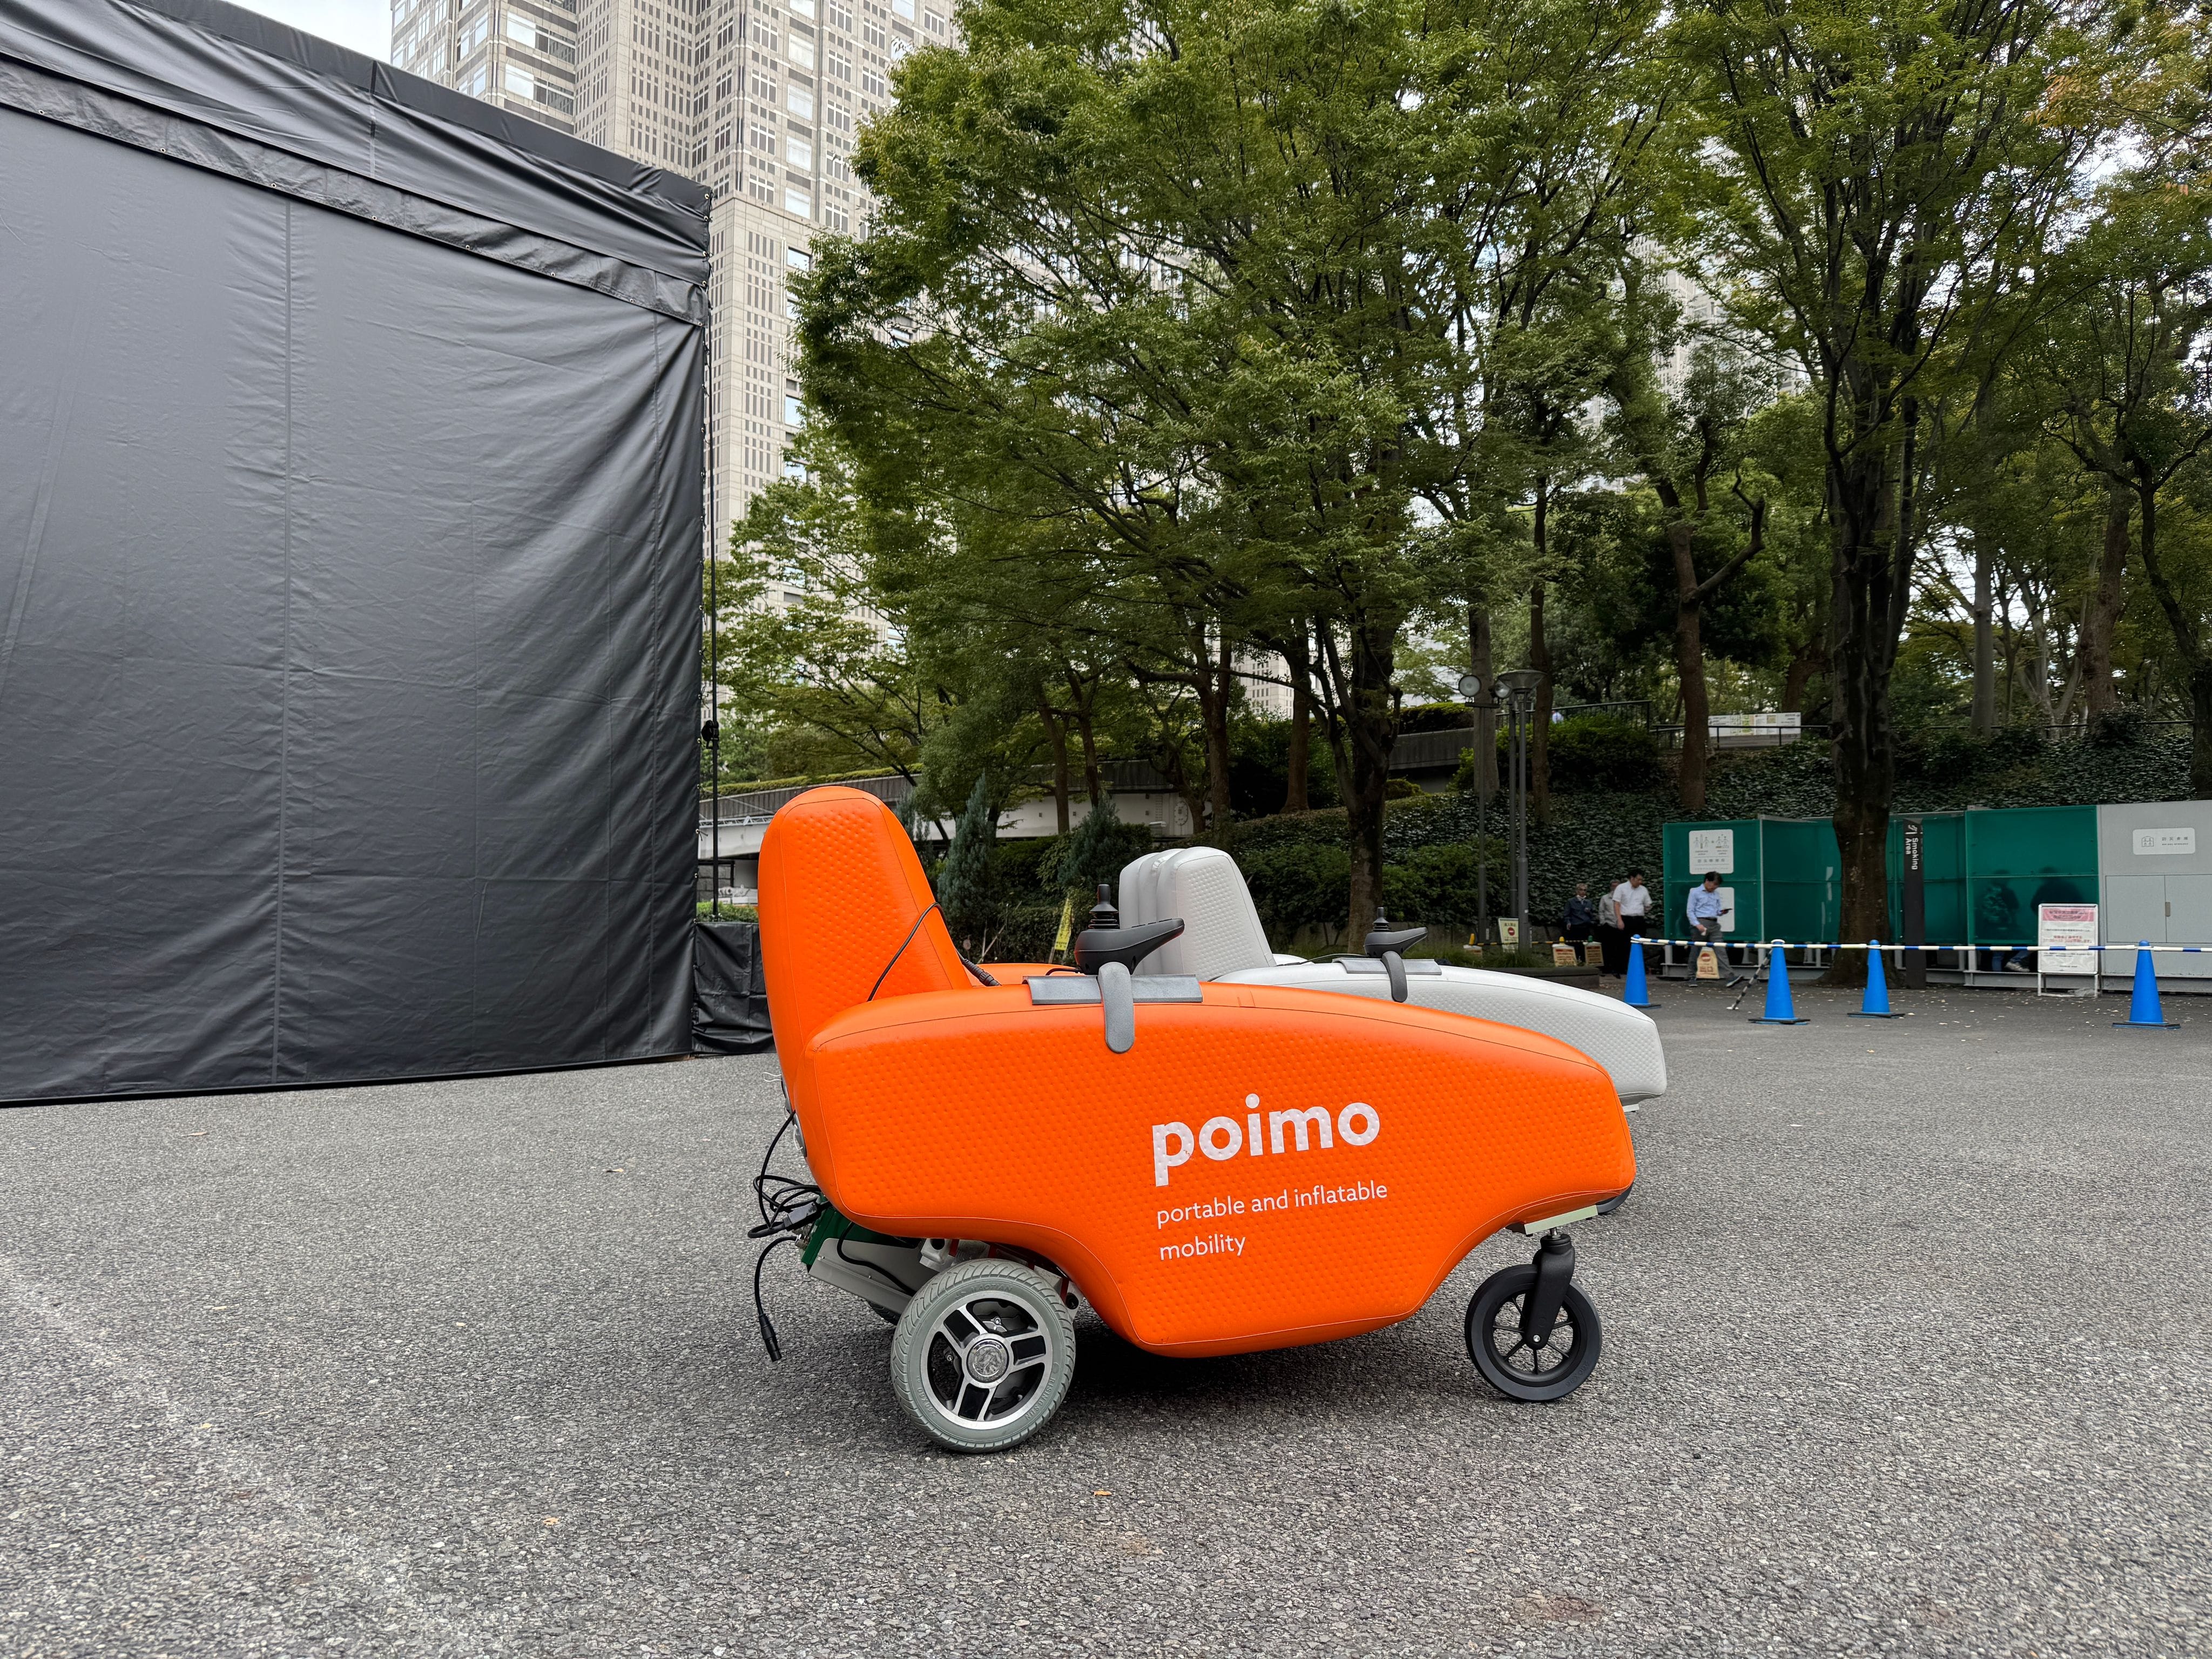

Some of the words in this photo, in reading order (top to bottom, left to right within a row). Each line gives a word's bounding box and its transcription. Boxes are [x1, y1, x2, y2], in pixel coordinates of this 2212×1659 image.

[1152, 1093, 1380, 1186] poimo
[1157, 1195, 1245, 1229] portable
[1251, 1189, 1289, 1212] and
[1294, 1180, 1387, 1208] inflatable
[1159, 1233, 1246, 1260] mobility
[1024, 1377, 1056, 1420] RISINGSUN
